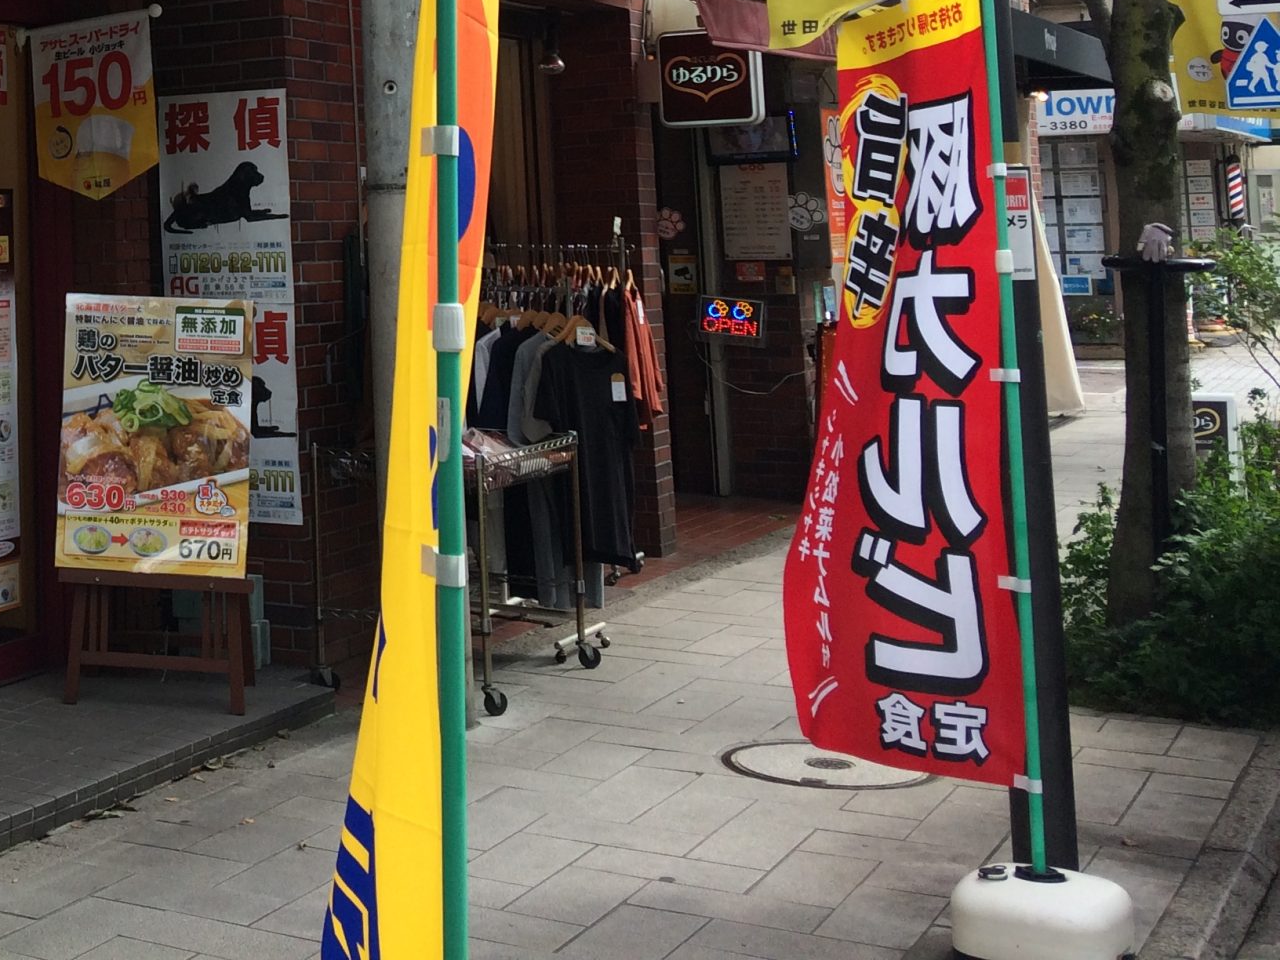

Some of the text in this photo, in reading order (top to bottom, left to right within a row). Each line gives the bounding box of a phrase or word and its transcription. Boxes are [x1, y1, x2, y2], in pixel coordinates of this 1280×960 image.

[671, 64, 738, 84] ゆるりら
[165, 96, 282, 155] 探偵
[170, 276, 200, 295] AG
[181, 316, 237, 335] 無添加
[703, 316, 757, 336] OPEN
